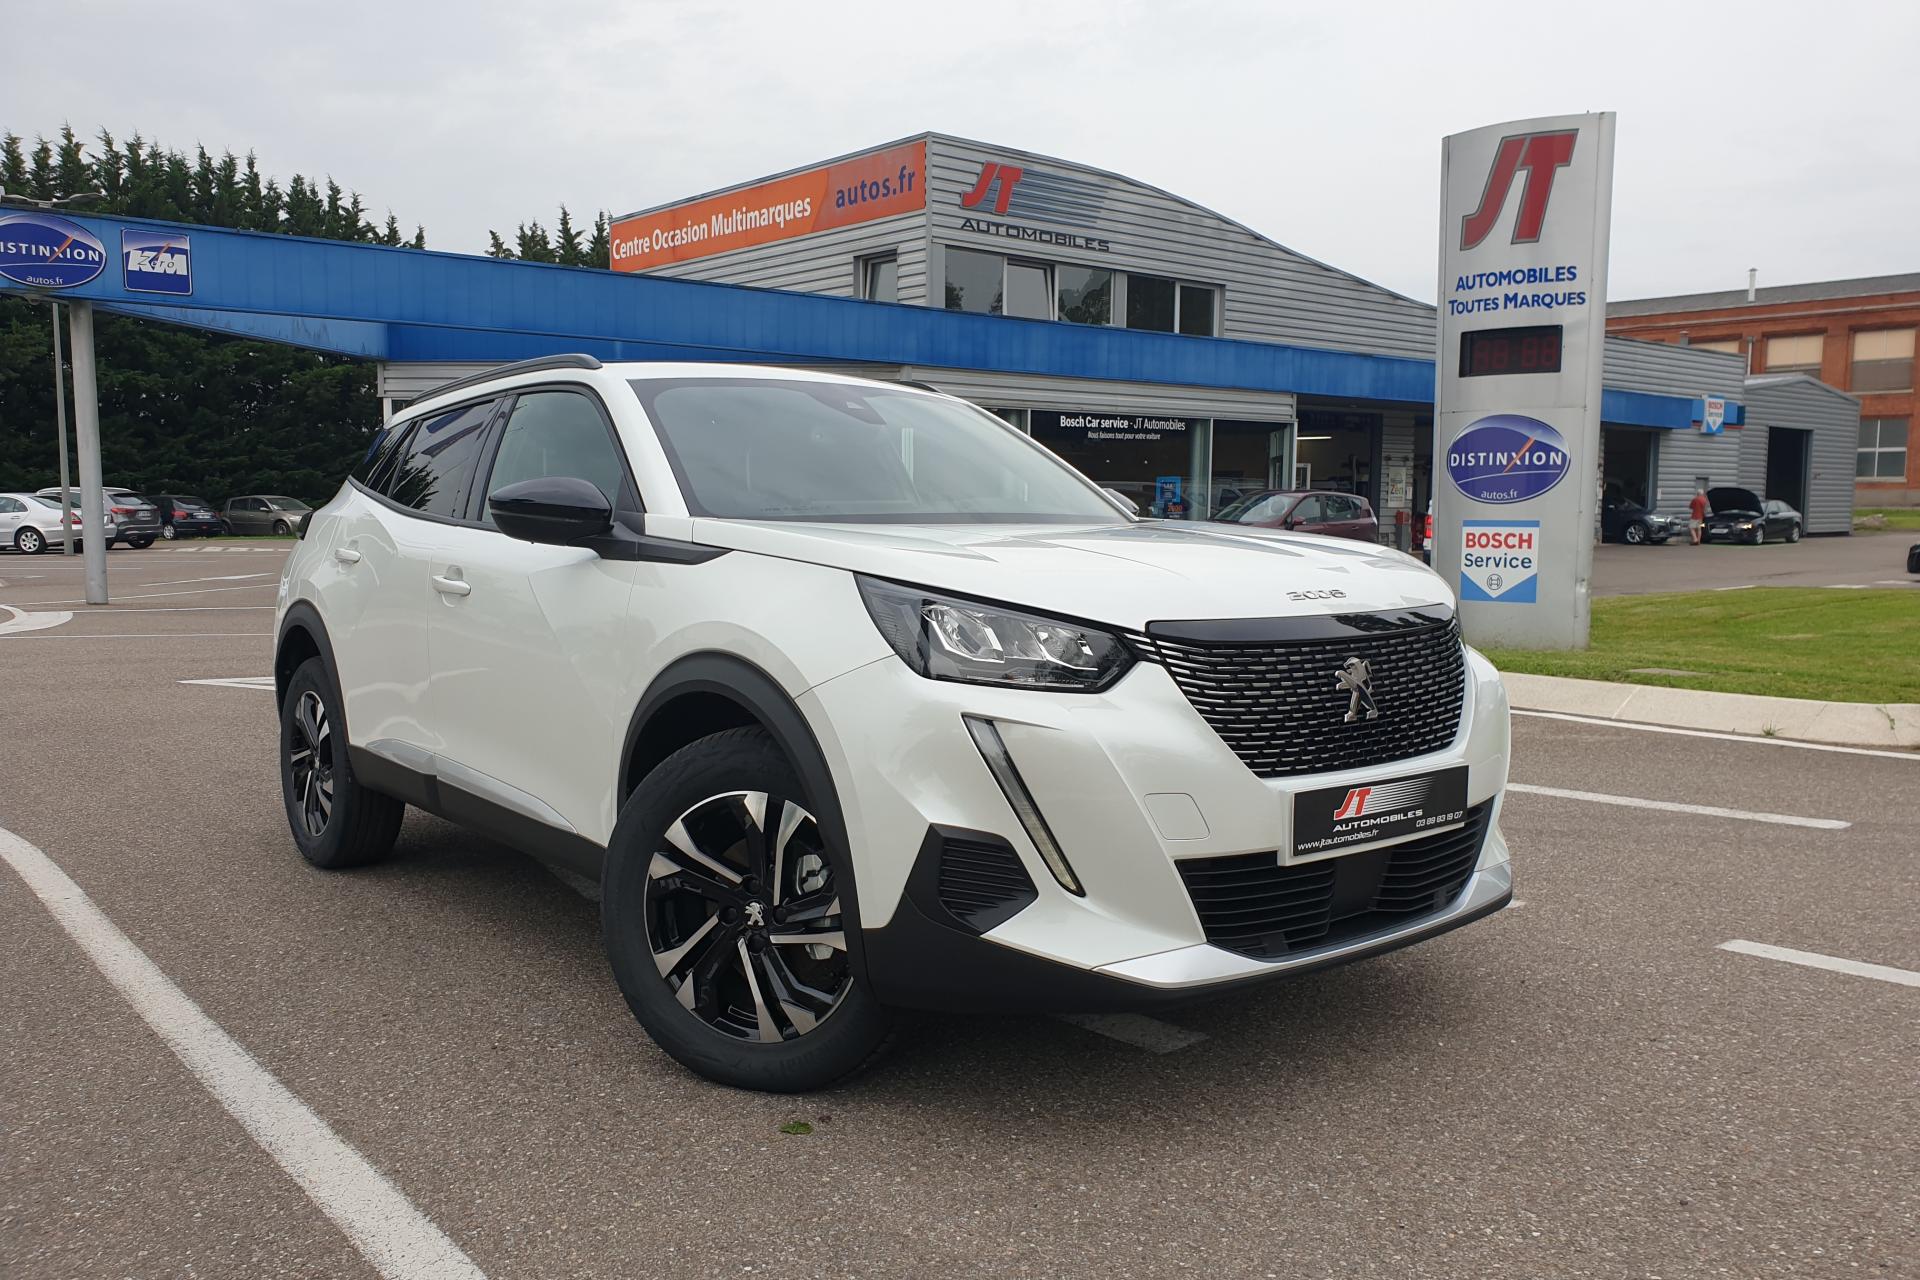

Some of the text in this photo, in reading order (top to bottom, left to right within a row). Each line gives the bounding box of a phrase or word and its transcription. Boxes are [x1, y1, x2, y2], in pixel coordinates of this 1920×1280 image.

[836, 165, 915, 209] autos.fr
[959, 160, 1024, 216] JT
[1460, 128, 1579, 251] JT
[613, 197, 811, 260] Centre Occasion Multimarques
[961, 218, 1110, 252] AUTOMOBILES
[0, 241, 100, 262] ISTINXION
[26, 275, 63, 285] autos.fr
[1455, 266, 1577, 292] AUTOMOBILES
[1060, 415, 1084, 427] Bosch
[1086, 416, 1099, 427] Car
[1101, 417, 1128, 429] service
[1133, 418, 1142, 429] JT
[1143, 418, 1186, 431] Automobiles
[1451, 451, 1562, 467] DISTINXION
[1481, 489, 1518, 500] autos.fr
[1465, 533, 1532, 549] BOSCH
[1464, 553, 1532, 569] Service
[1334, 787, 1372, 820] JT
[1333, 809, 1423, 832] AUTOMOBILES
[1416, 819, 1426, 828] 03
[1454, 810, 1463, 819] 07
[1297, 829, 1379, 851] www.jtautomobiles.fr
